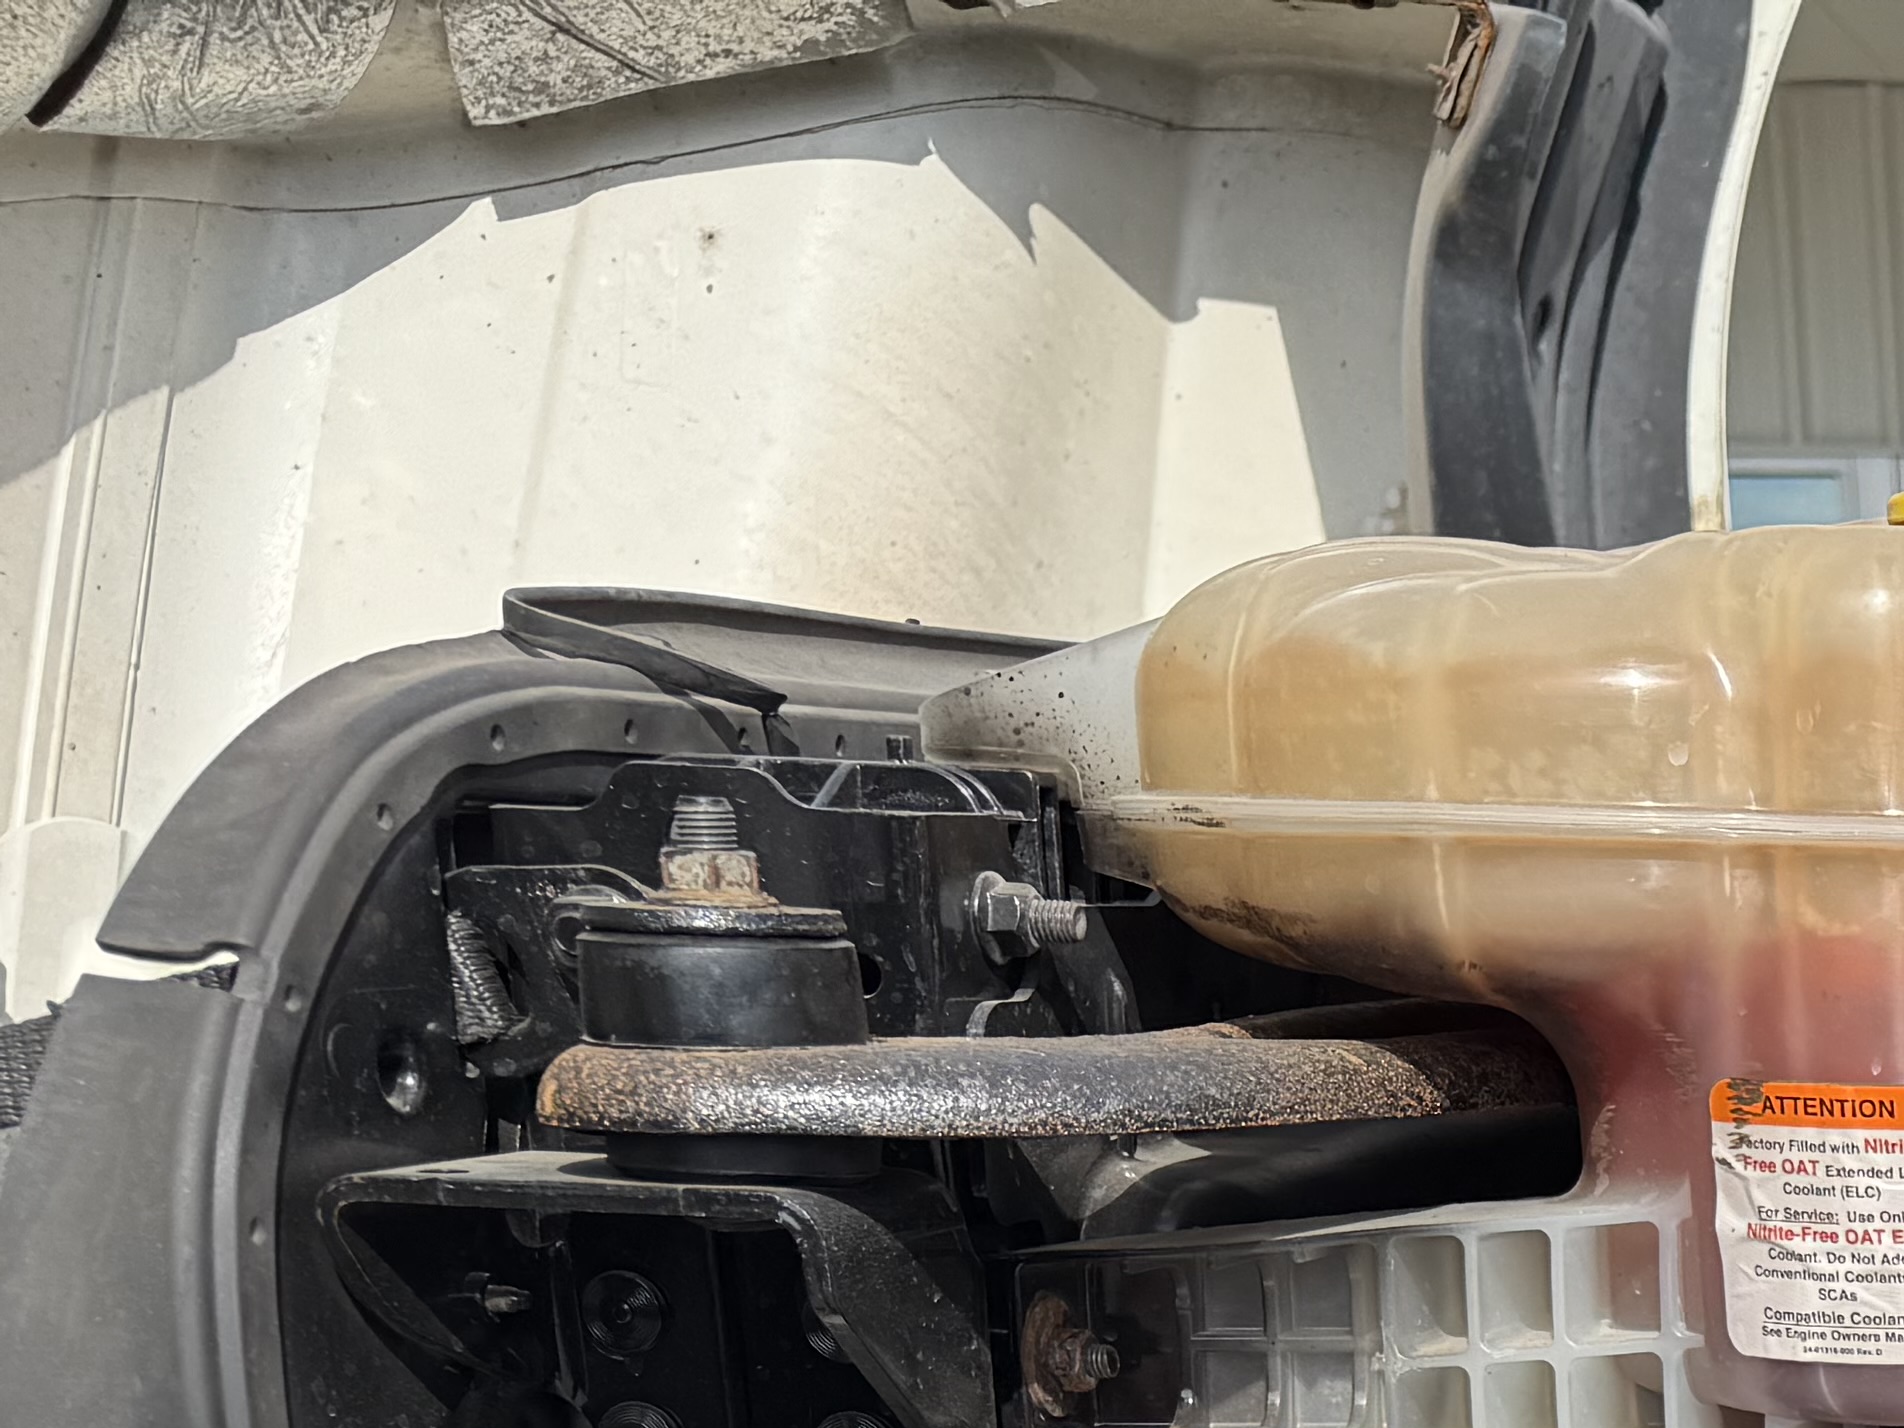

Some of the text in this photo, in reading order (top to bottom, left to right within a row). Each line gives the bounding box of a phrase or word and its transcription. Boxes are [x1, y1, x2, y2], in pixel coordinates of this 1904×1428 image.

[1761, 1095, 1895, 1119] ATTENTION
[1789, 1139, 1826, 1153] Filled
[1829, 1141, 1860, 1154] with
[1744, 1156, 1777, 1174] Free
[1782, 1157, 1820, 1176] OAT
[1825, 1164, 1893, 1179] Extended
[1783, 1182, 1882, 1201] Coolant (ELC)
[1758, 1206, 1779, 1220] For
[1847, 1211, 1875, 1224] Use
[1845, 1229, 1885, 1245] OAT
[1827, 1251, 1846, 1264] Do
[1851, 1252, 1876, 1265] Not
[1754, 1265, 1839, 1283] Conventional
[1818, 1288, 1858, 1301] SCAs
[1764, 1306, 1845, 1325] Compatible
[1762, 1325, 1783, 1338] See
[1786, 1327, 1828, 1342] Engine
[1831, 1330, 1881, 1342] Owners
